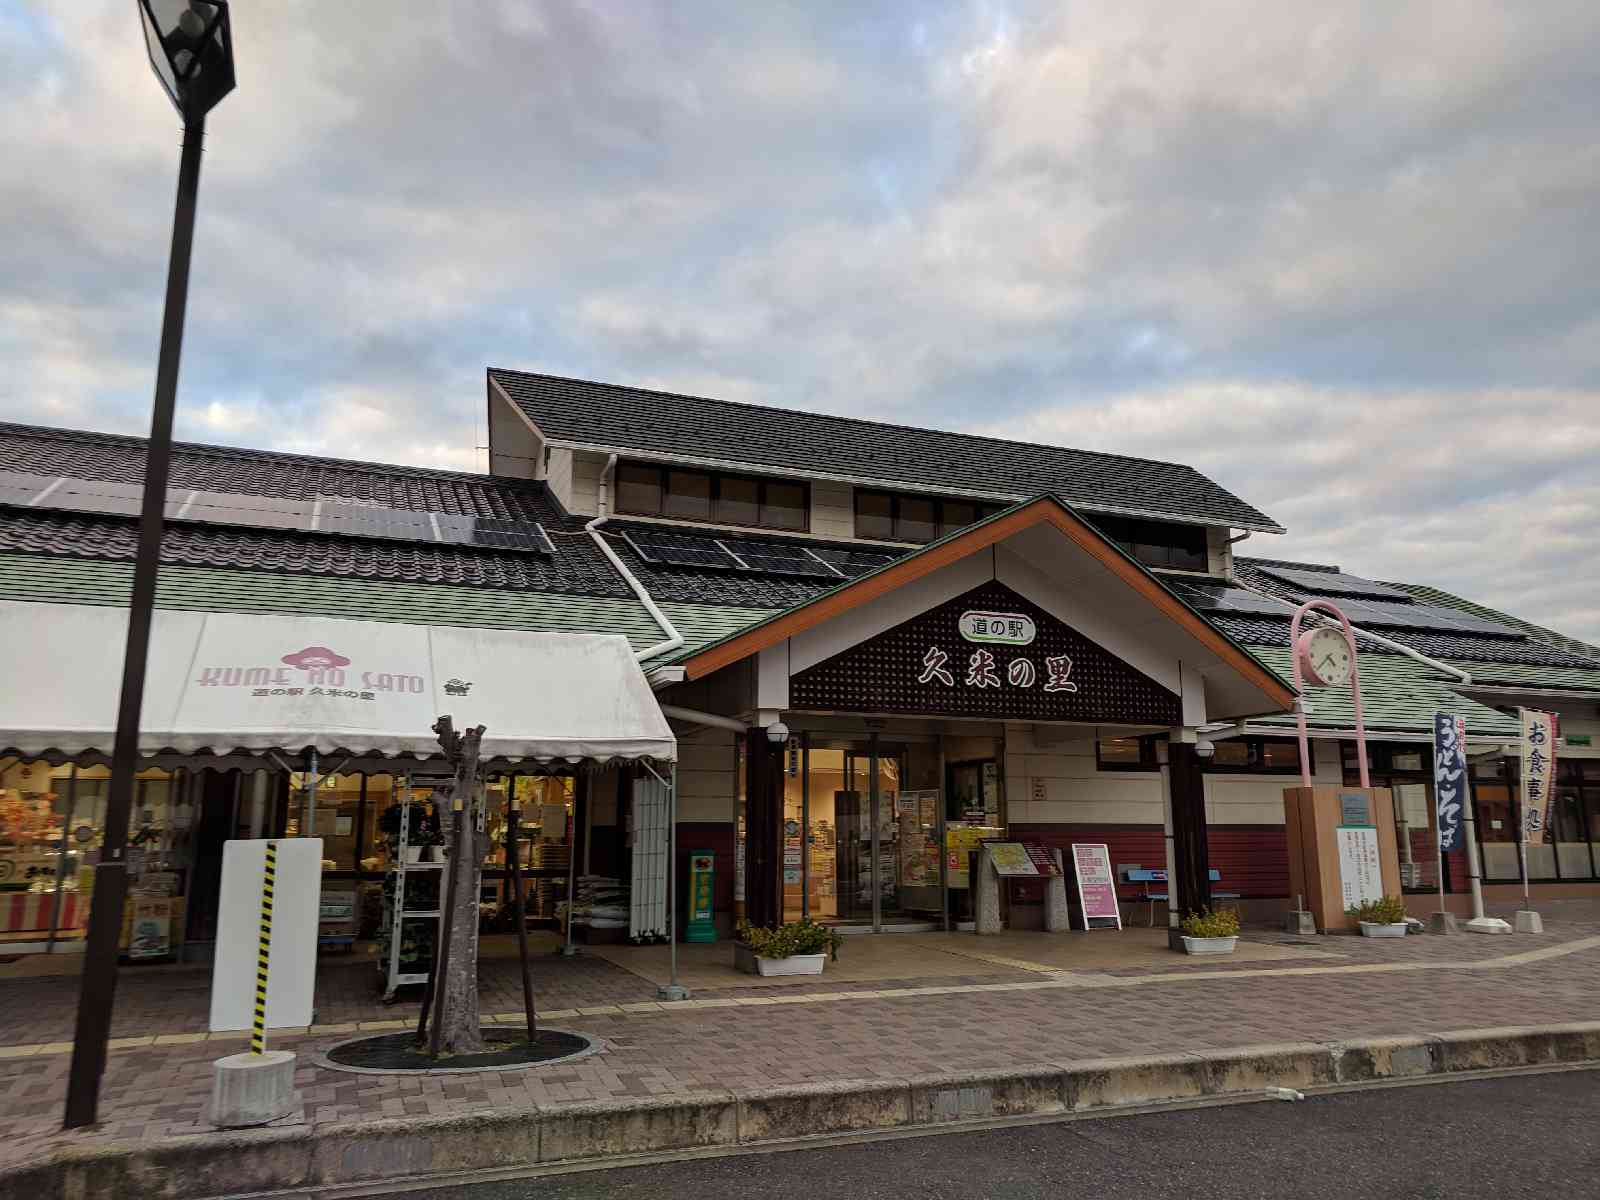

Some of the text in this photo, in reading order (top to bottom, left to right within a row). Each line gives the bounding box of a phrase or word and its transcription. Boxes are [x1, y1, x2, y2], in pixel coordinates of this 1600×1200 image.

[972, 618, 1025, 638] 道の駅
[196, 667, 425, 694] KUME NO SATO
[918, 647, 1078, 693] 久米の里
[251, 687, 376, 701] 道の駅 久米の里
[1527, 720, 1547, 833] お食事処
